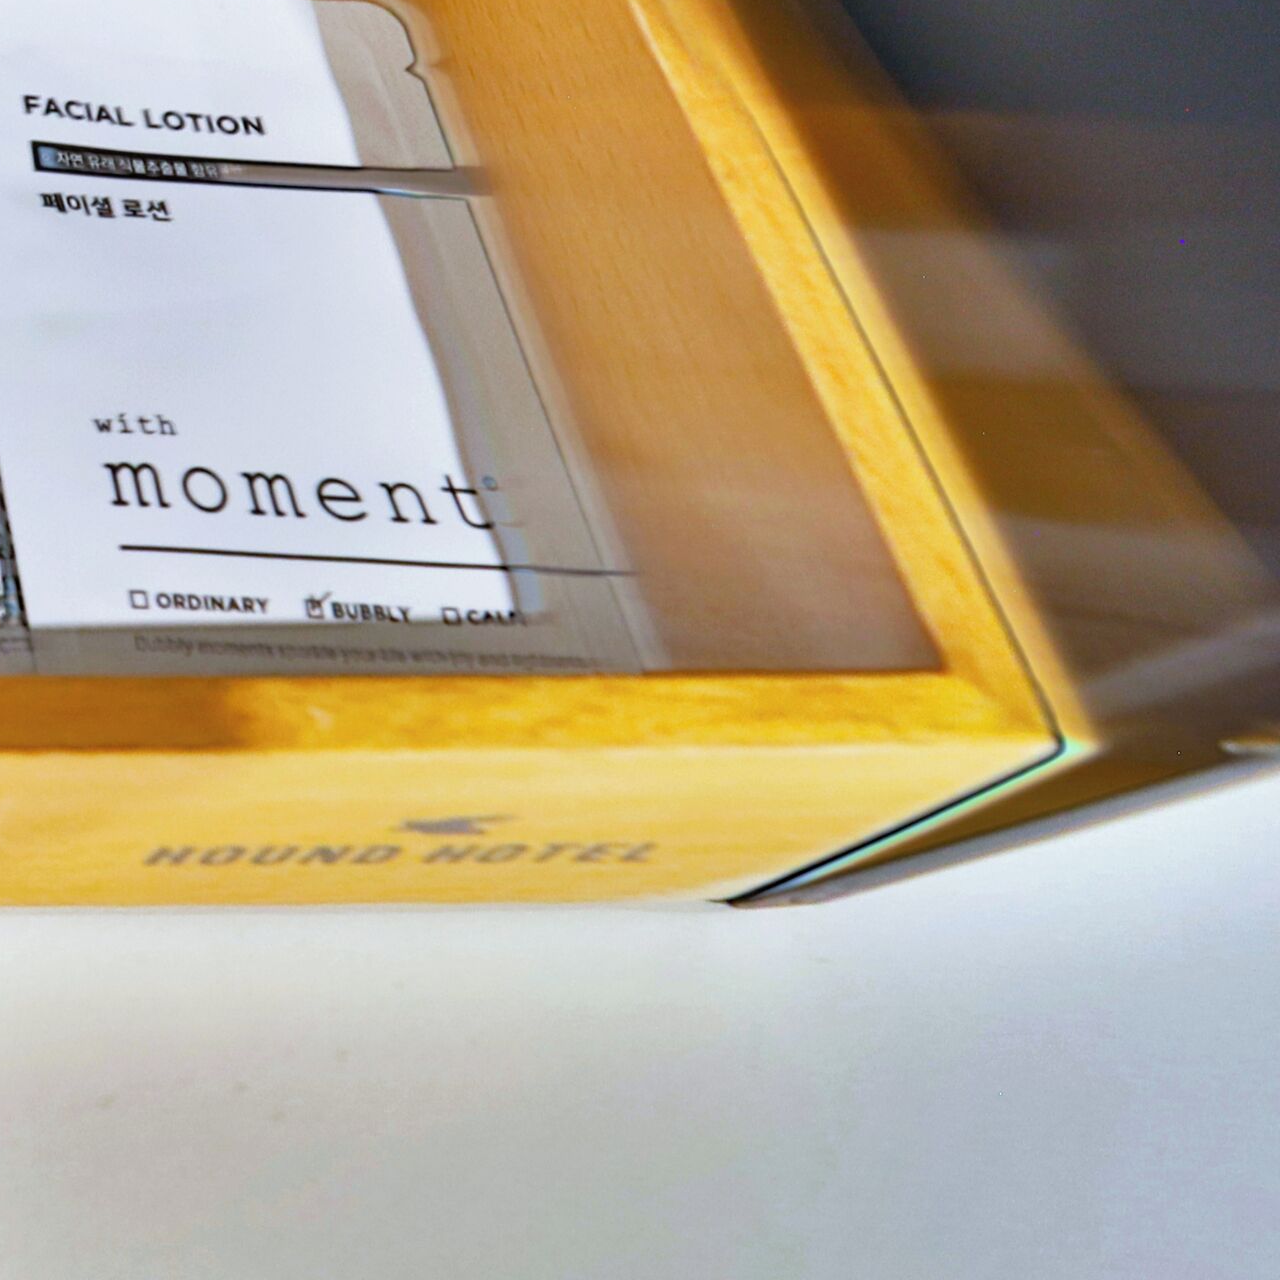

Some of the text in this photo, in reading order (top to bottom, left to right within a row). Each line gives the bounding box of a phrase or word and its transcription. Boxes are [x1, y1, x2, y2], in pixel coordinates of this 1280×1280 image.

[24, 94, 266, 136] FACIAL LOTION
[40, 192, 173, 222] 페이셜 로션
[94, 414, 179, 436] with
[103, 462, 495, 530] moment
[156, 592, 269, 614] ORDINARY
[331, 600, 411, 623] BUBBLY
[143, 841, 657, 868] HOUND HOTEL
